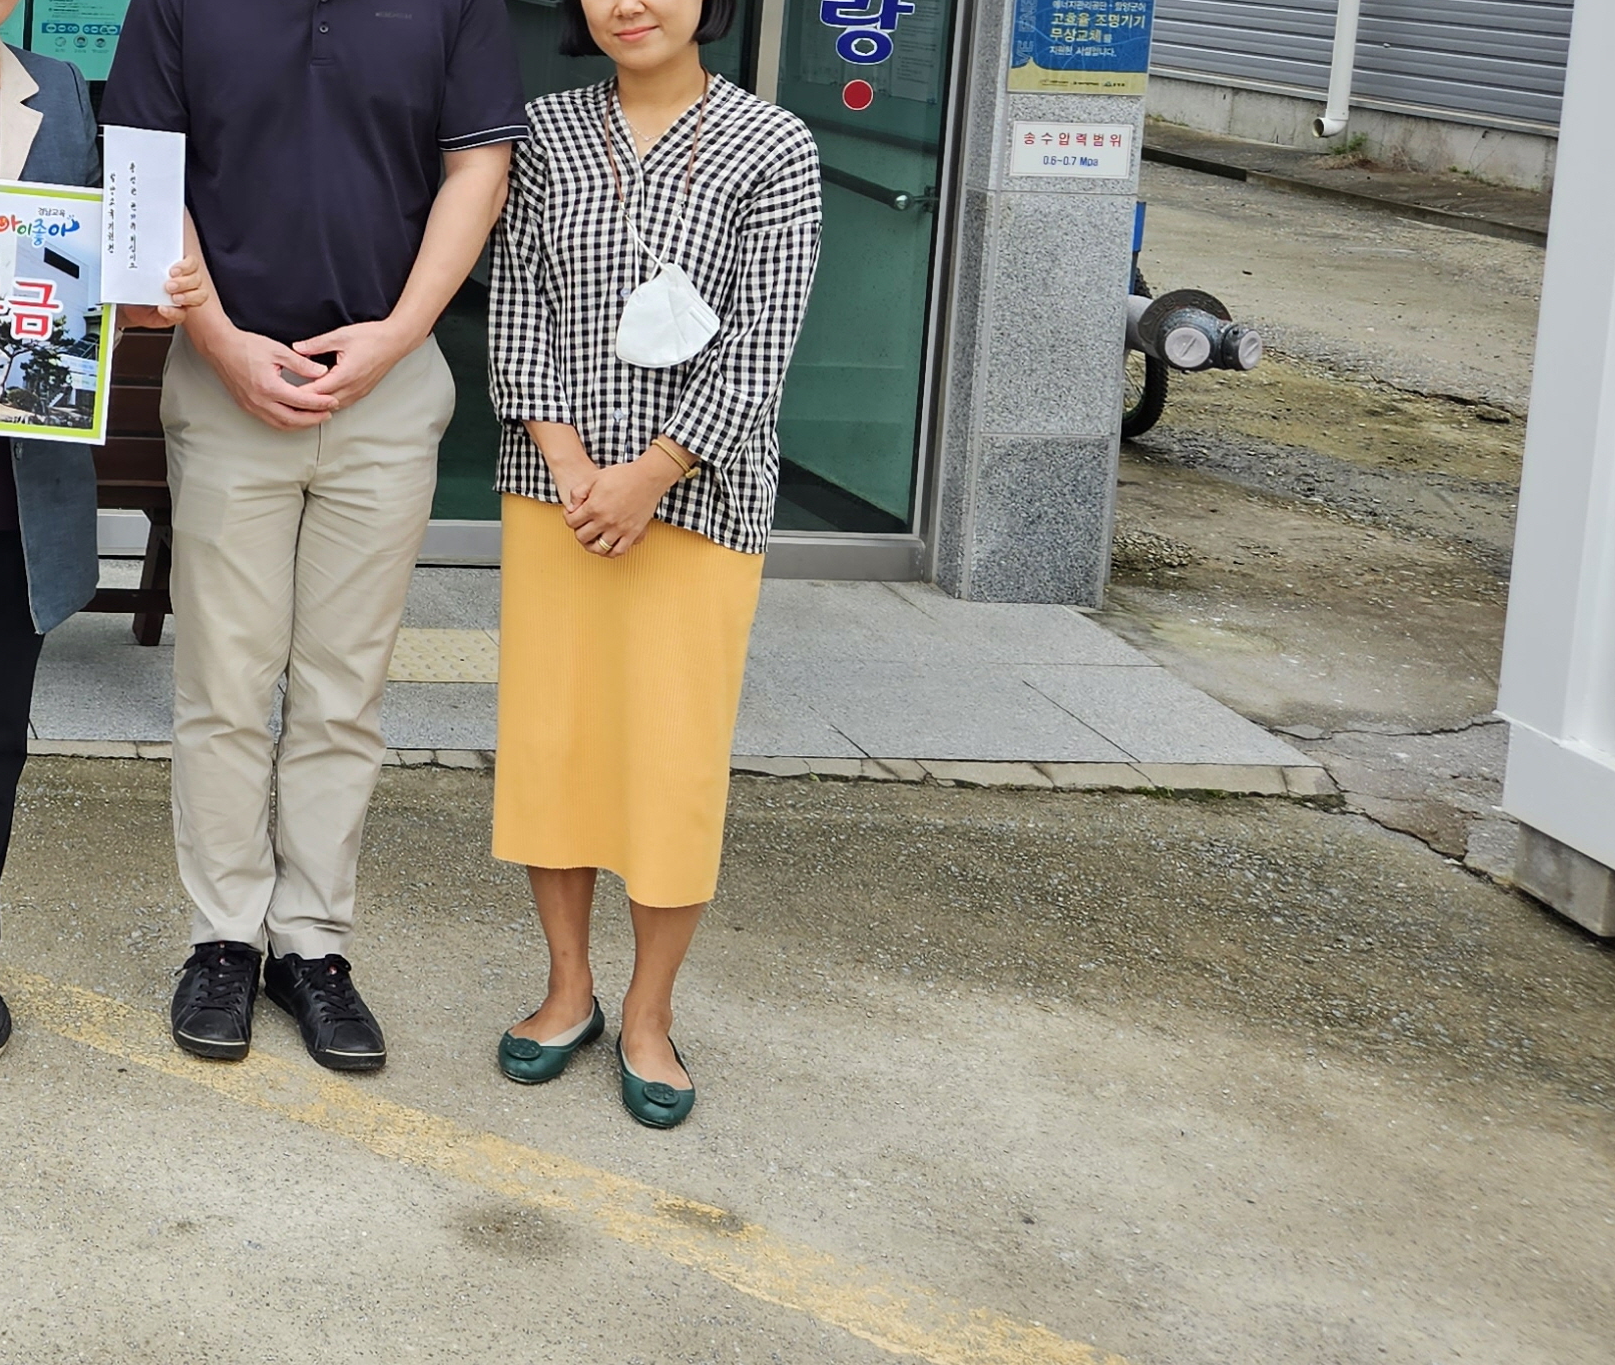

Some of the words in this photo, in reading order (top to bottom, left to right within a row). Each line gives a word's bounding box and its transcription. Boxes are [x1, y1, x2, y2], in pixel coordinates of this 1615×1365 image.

[1050, 12, 1090, 27] 고효율
[1095, 13, 1146, 29] 조명기기
[1079, 156, 1099, 167] Mpa
